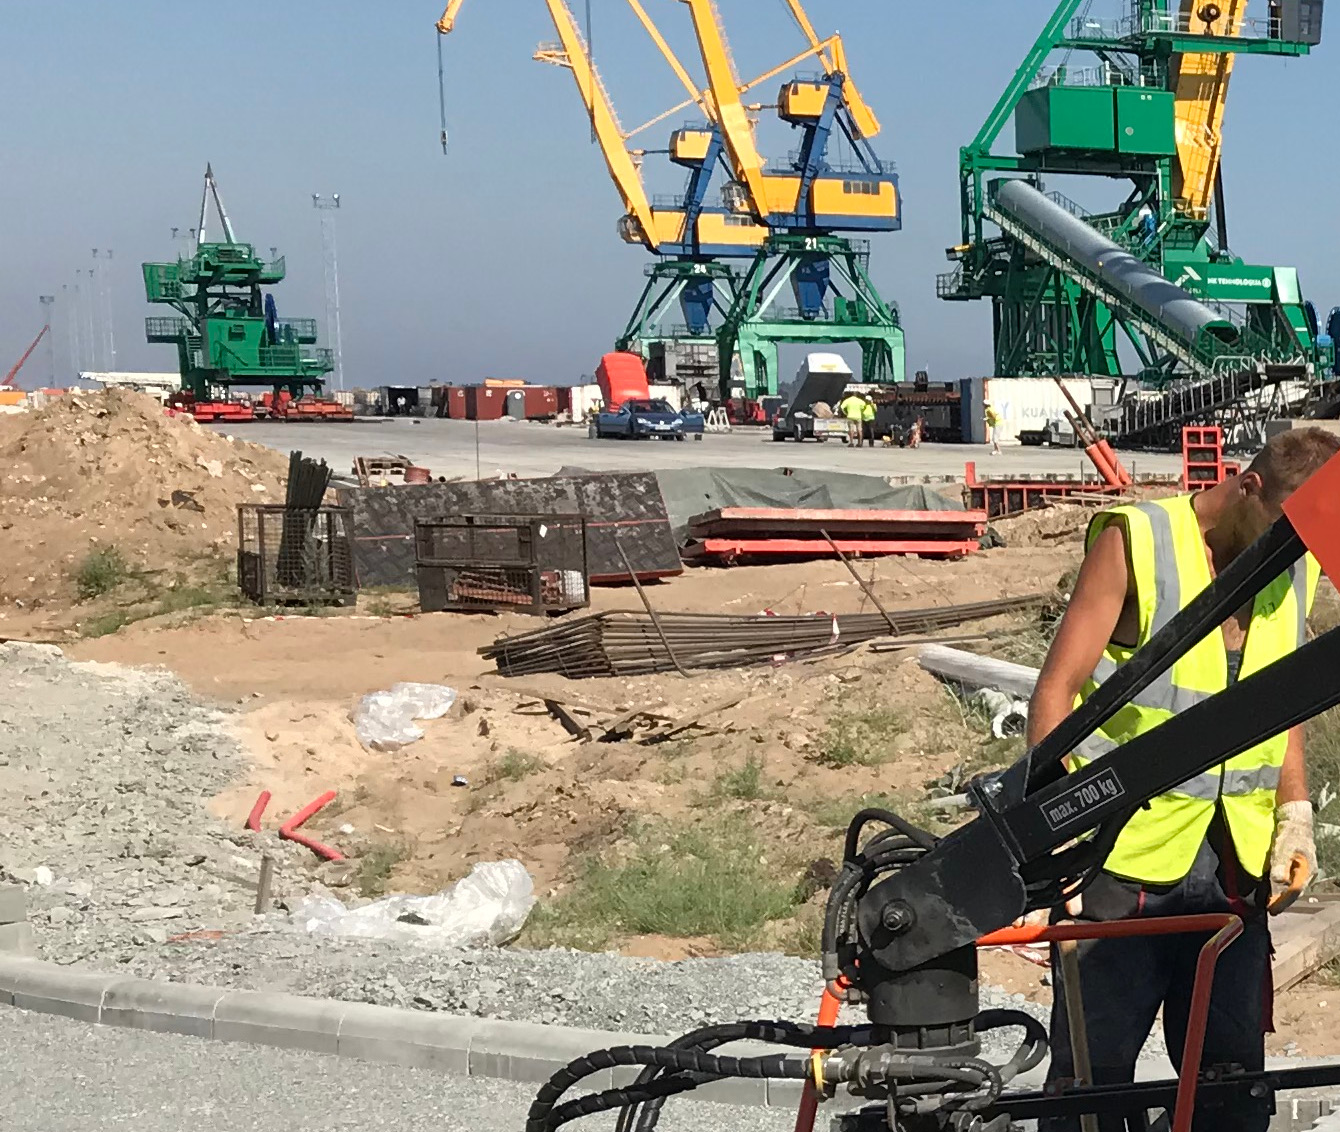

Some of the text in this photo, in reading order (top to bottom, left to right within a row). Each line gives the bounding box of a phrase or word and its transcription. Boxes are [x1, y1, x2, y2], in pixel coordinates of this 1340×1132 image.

[804, 237, 817, 250] 21
[1048, 778, 1117, 822] max. 700 kg
